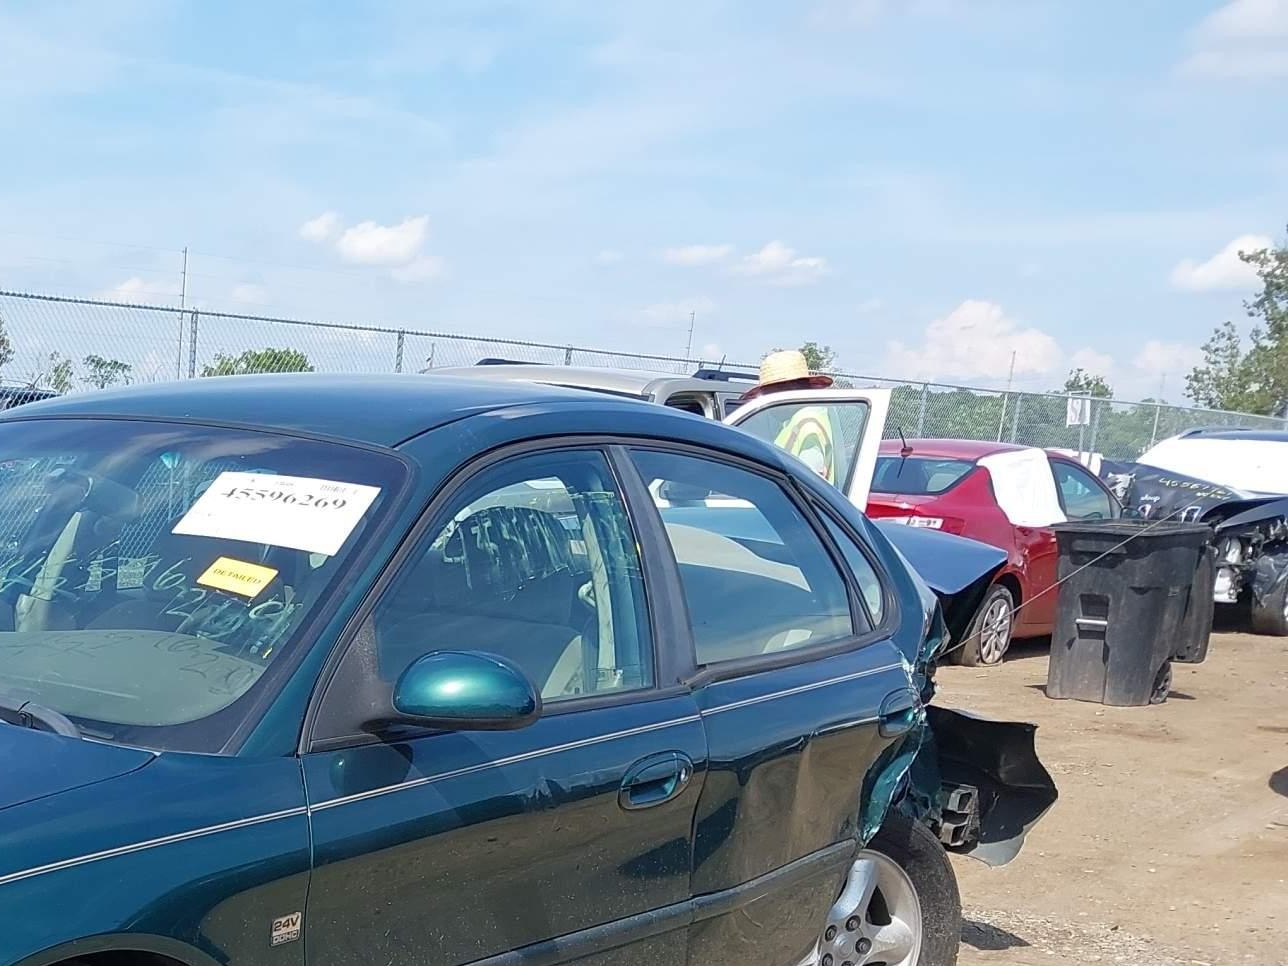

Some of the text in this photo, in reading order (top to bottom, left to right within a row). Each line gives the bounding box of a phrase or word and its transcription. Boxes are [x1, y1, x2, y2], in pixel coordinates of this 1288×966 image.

[221, 487, 347, 510] 45596269
[213, 568, 262, 584] DETAILED
[274, 914, 300, 932] 24V
